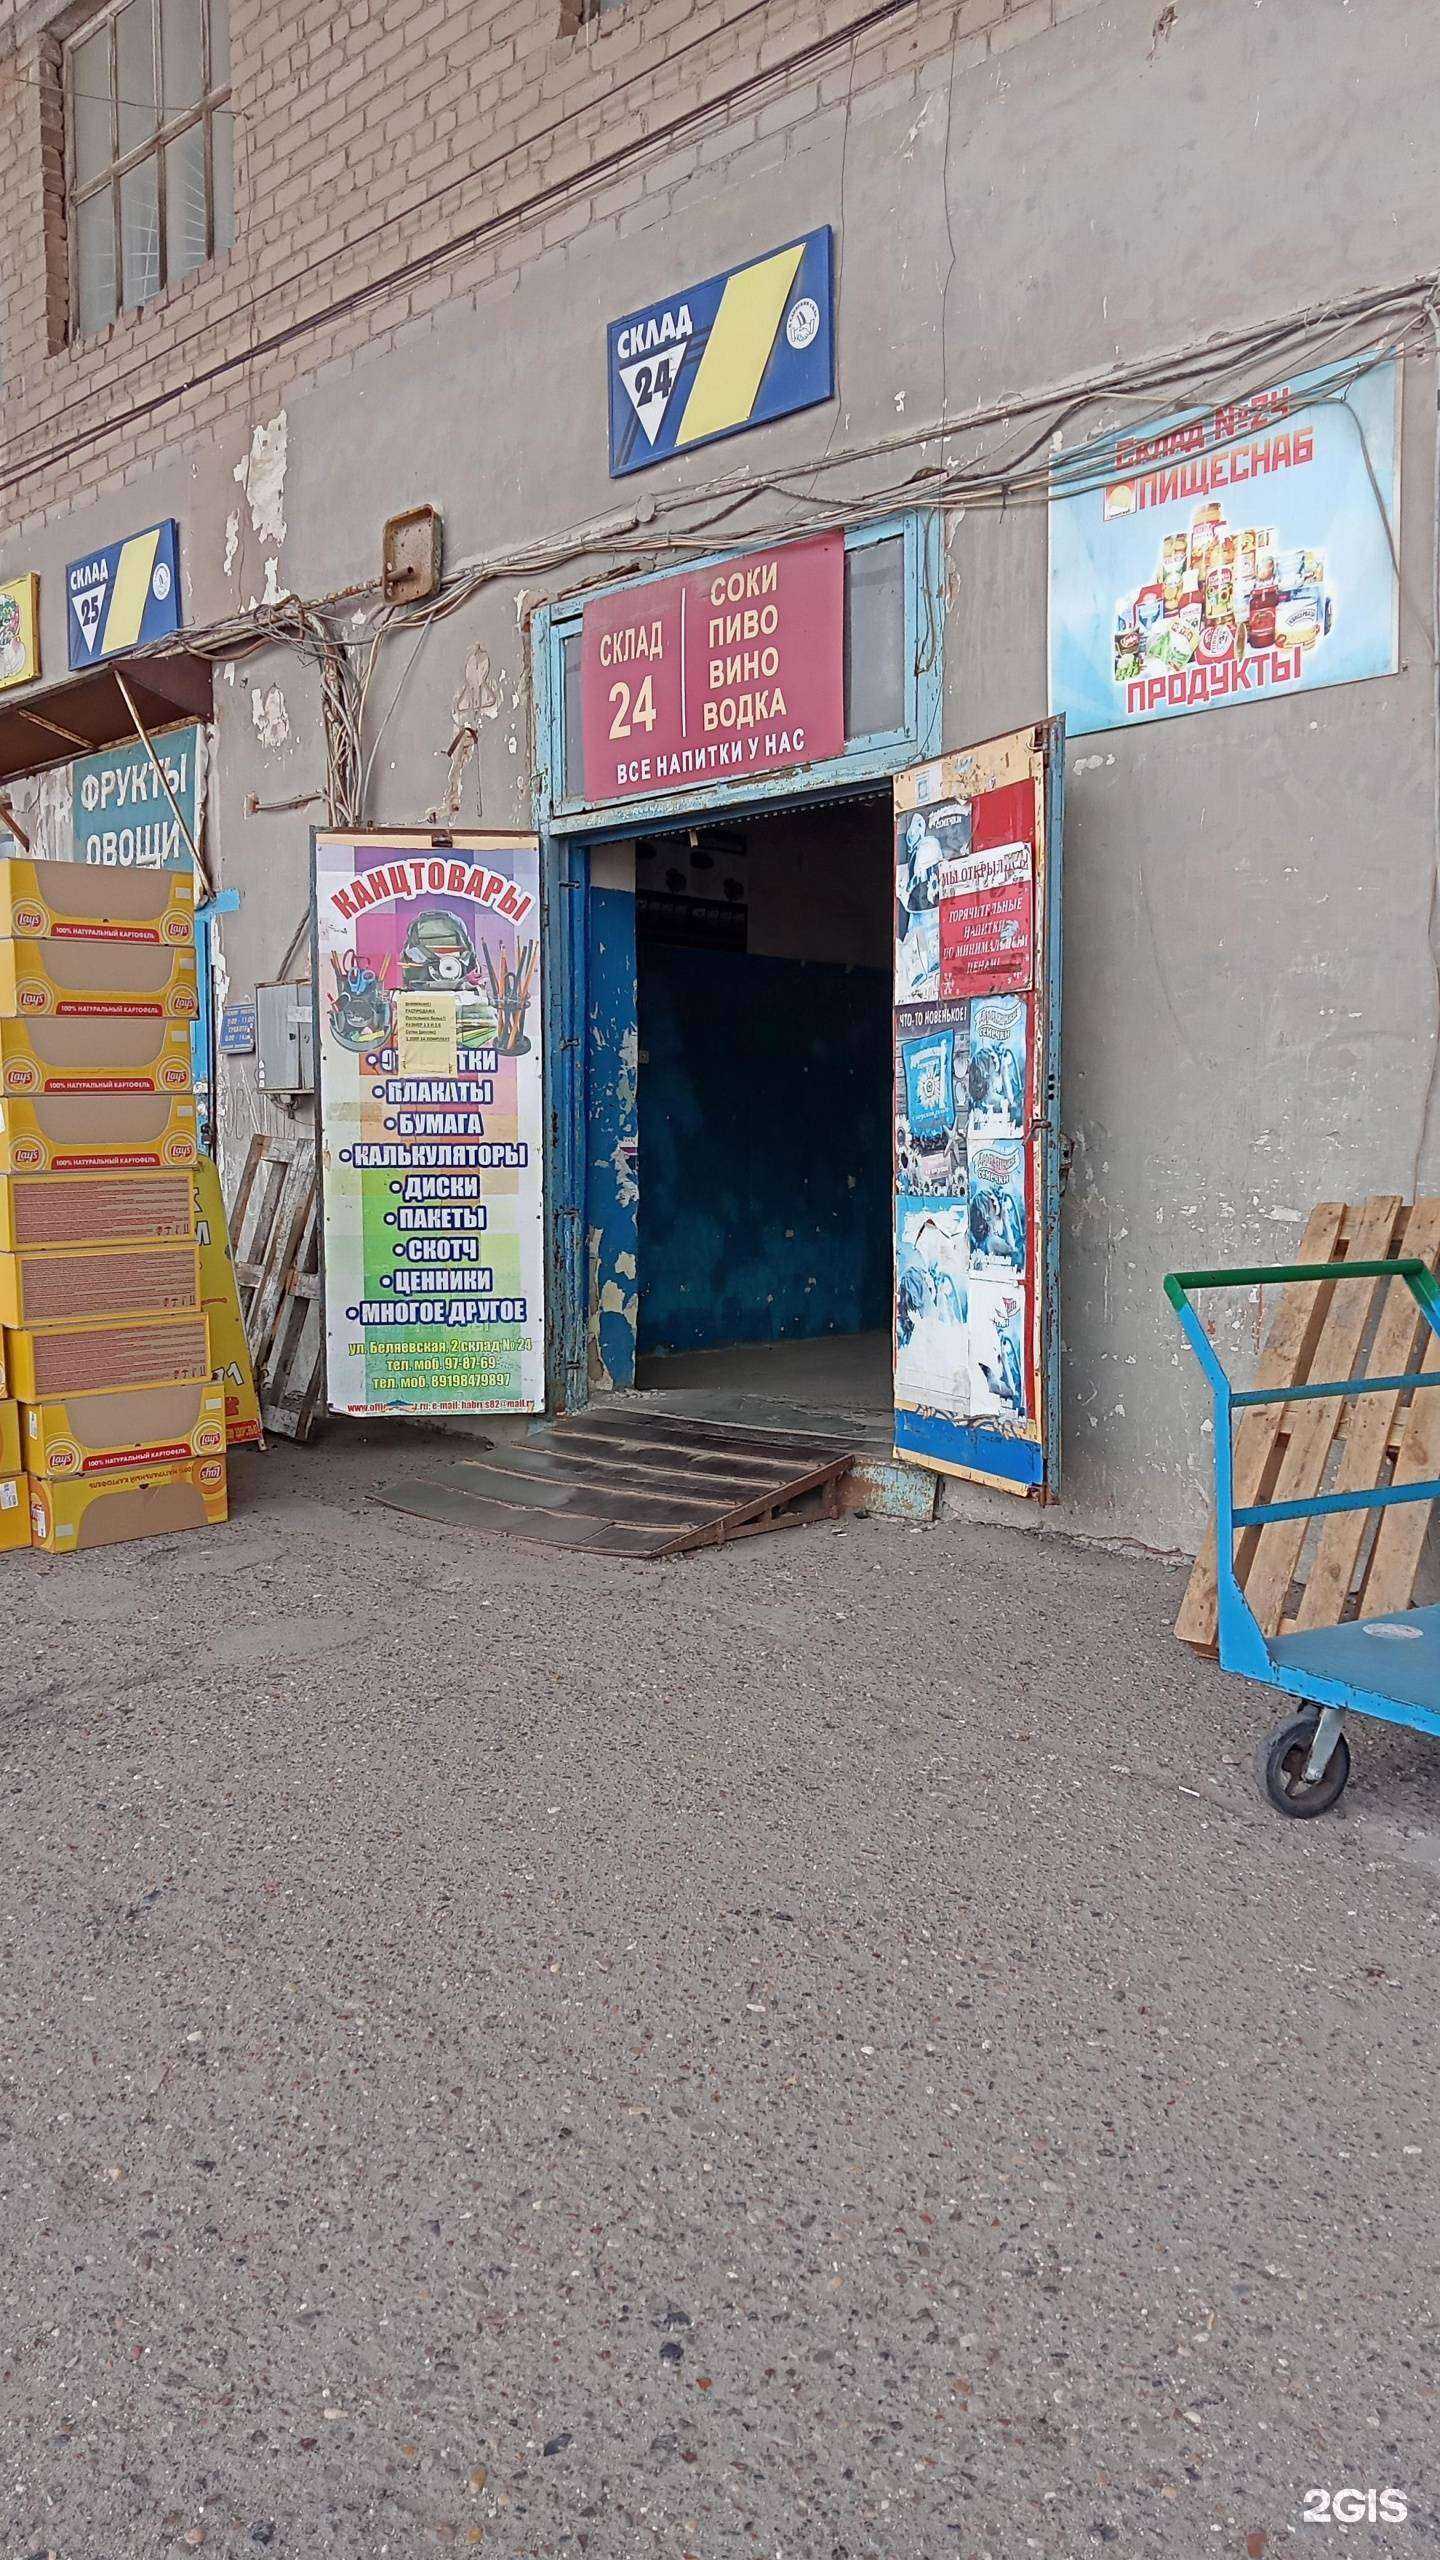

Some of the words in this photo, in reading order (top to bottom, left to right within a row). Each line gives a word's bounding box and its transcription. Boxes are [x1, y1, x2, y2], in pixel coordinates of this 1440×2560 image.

[617, 304, 693, 359] СКЛАД
[634, 358, 673, 409] 24
[1138, 426, 1314, 511] ПИЩЕСНАБ
[70, 558, 109, 591] СКЛАД
[710, 561, 778, 607] СОКИ
[80, 592, 100, 628] 25
[708, 604, 779, 649] ПИВО
[599, 620, 663, 667] СКЛАД
[708, 646, 780, 690] ВИНО
[1126, 645, 1302, 714] ПРОДУКТЫ
[608, 674, 657, 741] 24
[703, 686, 788, 732] ВОДКА
[617, 760, 651, 785] ВСЕ
[656, 739, 743, 777] НАПИТКИ
[748, 738, 760, 760] У
[765, 728, 805, 757] НАС
[80, 753, 187, 812] ФРУКТЫ
[86, 822, 181, 869] ОВОЩИ
[330, 860, 532, 922] КАНЦТОВАРЫ
[387, 1080, 492, 1104] ПЛАКАТЫ
[399, 1112, 483, 1135] БУМАГА
[353, 1143, 527, 1167] КАЛЬКУЛЯТОРЫ
[403, 1175, 480, 1201] ДИСКИ
[398, 1206, 486, 1230] ПАКЕТЫ
[407, 1238, 479, 1261] СКОТЧ
[394, 1269, 492, 1294] ЦЕННИКИ
[361, 1301, 446, 1324] МНОГОЕ
[448, 1300, 526, 1326] ДРУГОЕ
[348, 1342, 367, 1357] ул.
[459, 1339, 499, 1354] склад
[387, 1359, 412, 1371] тел.
[414, 1357, 441, 1371] моб.
[444, 1356, 496, 1370] 97-87-69
[373, 1376, 399, 1390] тел.
[400, 1375, 429, 1389] моб.
[431, 1373, 511, 1388] 89198479897
